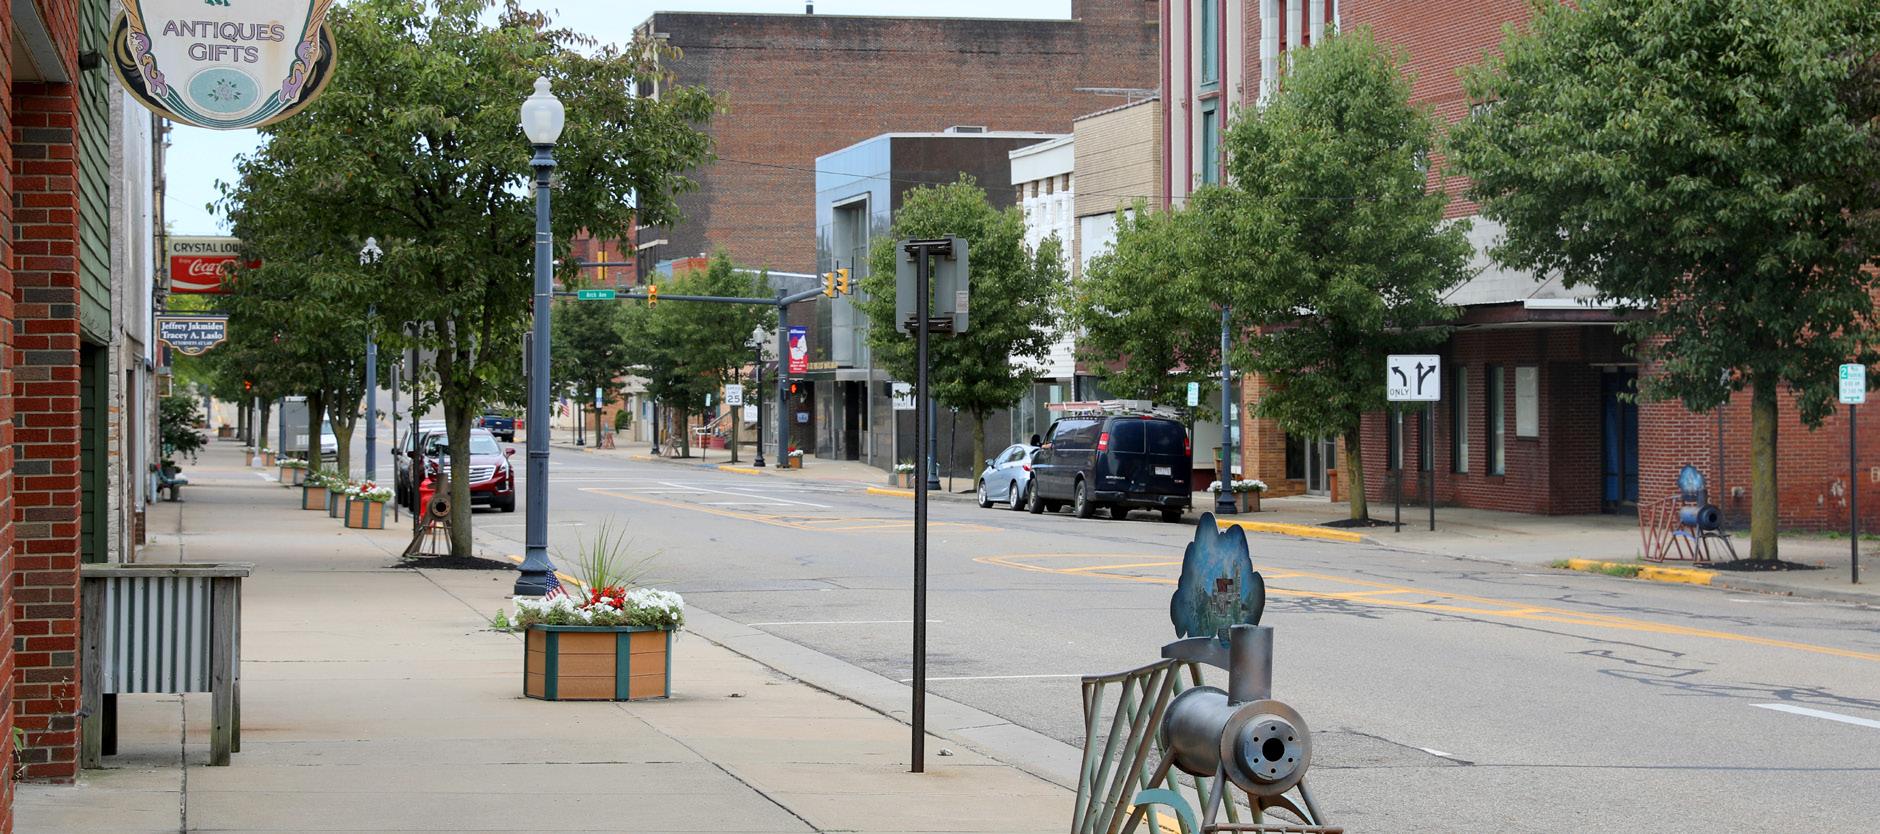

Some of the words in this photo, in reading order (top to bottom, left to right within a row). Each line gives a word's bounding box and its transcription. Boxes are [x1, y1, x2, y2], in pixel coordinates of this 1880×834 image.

[162, 19, 285, 42] ANTIQUES
[188, 43, 258, 63] GIFTS
[173, 243, 218, 253] CRYSTAL
[221, 243, 241, 253] LOU
[161, 322, 188, 331] Jeffrey
[188, 322, 224, 331] Jakmides
[161, 331, 188, 340] Tracey
[190, 331, 199, 339] A.
[1841, 366, 1847, 378] 2
[727, 394, 740, 403] 25
